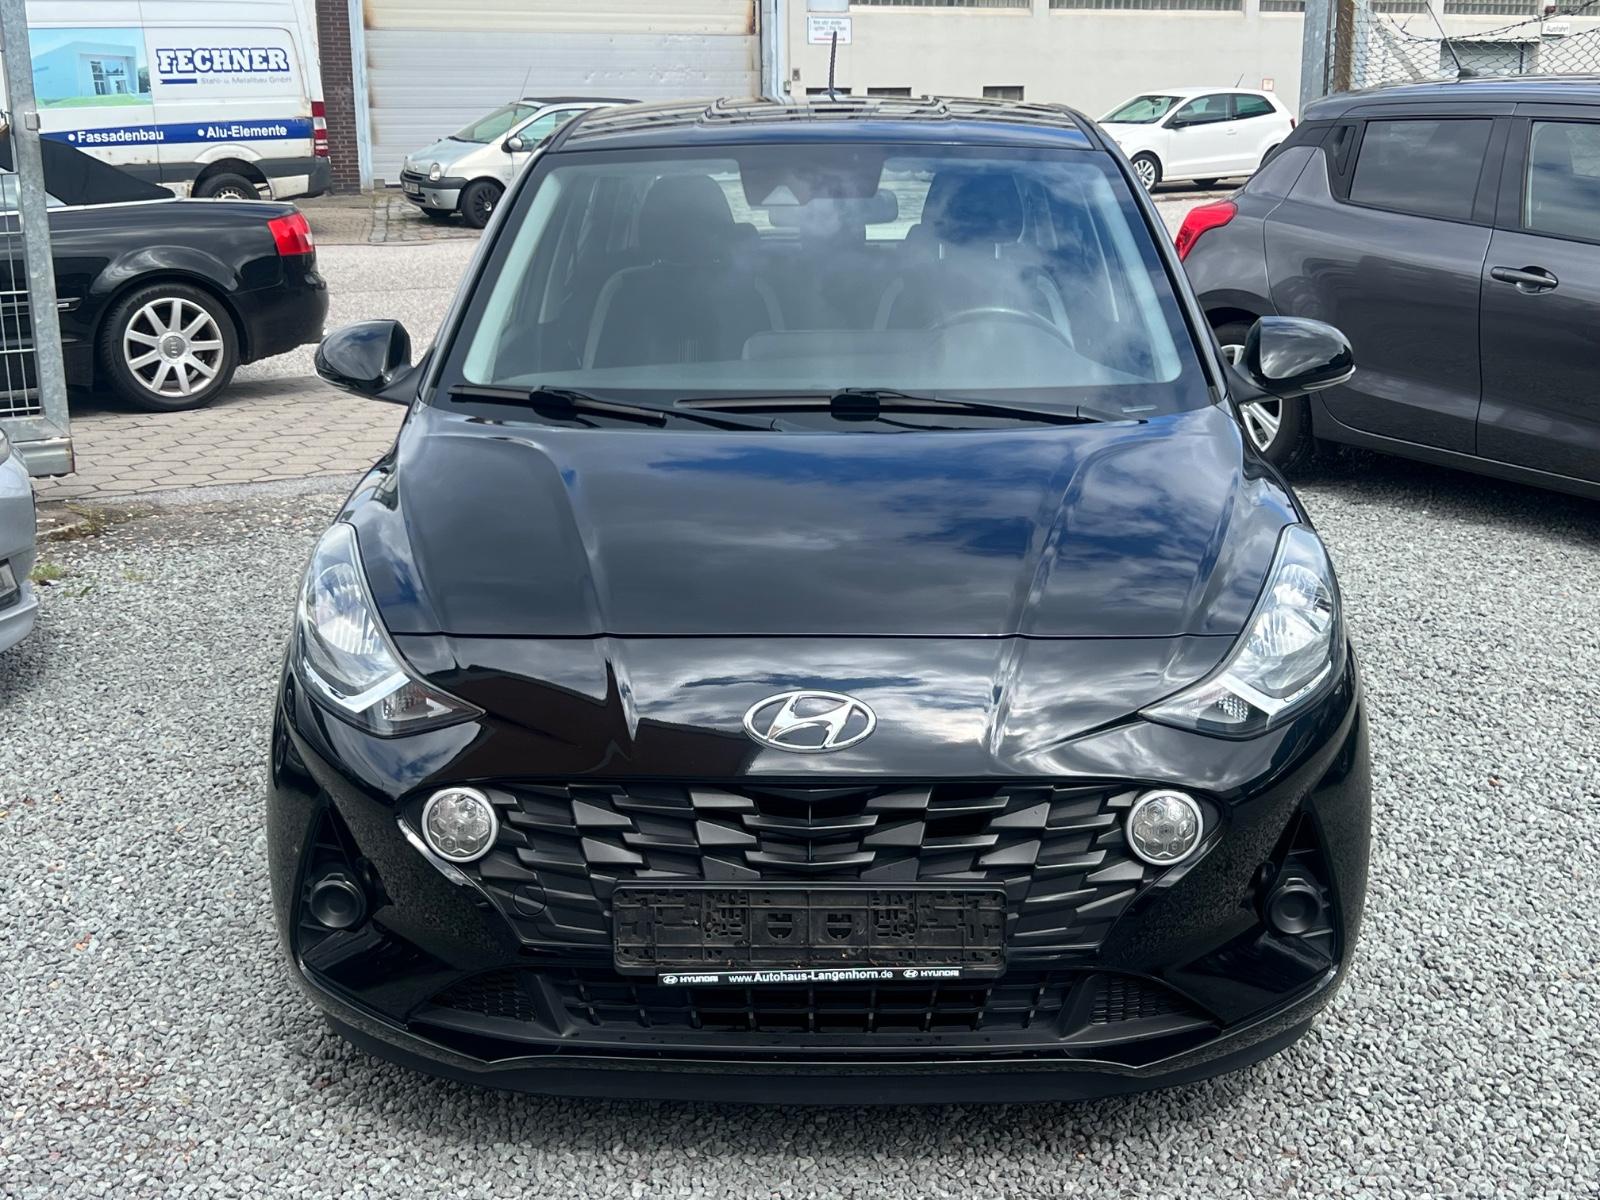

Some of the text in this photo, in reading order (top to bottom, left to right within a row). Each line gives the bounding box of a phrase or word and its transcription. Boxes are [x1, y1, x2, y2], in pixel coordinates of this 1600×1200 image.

[156, 48, 290, 74] FECHNER
[231, 76, 267, 84] Metallbau
[269, 75, 292, 84] GmbH
[77, 128, 164, 143] Fassadenbau
[206, 124, 288, 139] Alu-Elemente
[680, 969, 960, 983] HYUNDAI www.Autohaus-Langenhorn.de HYUNDAI
